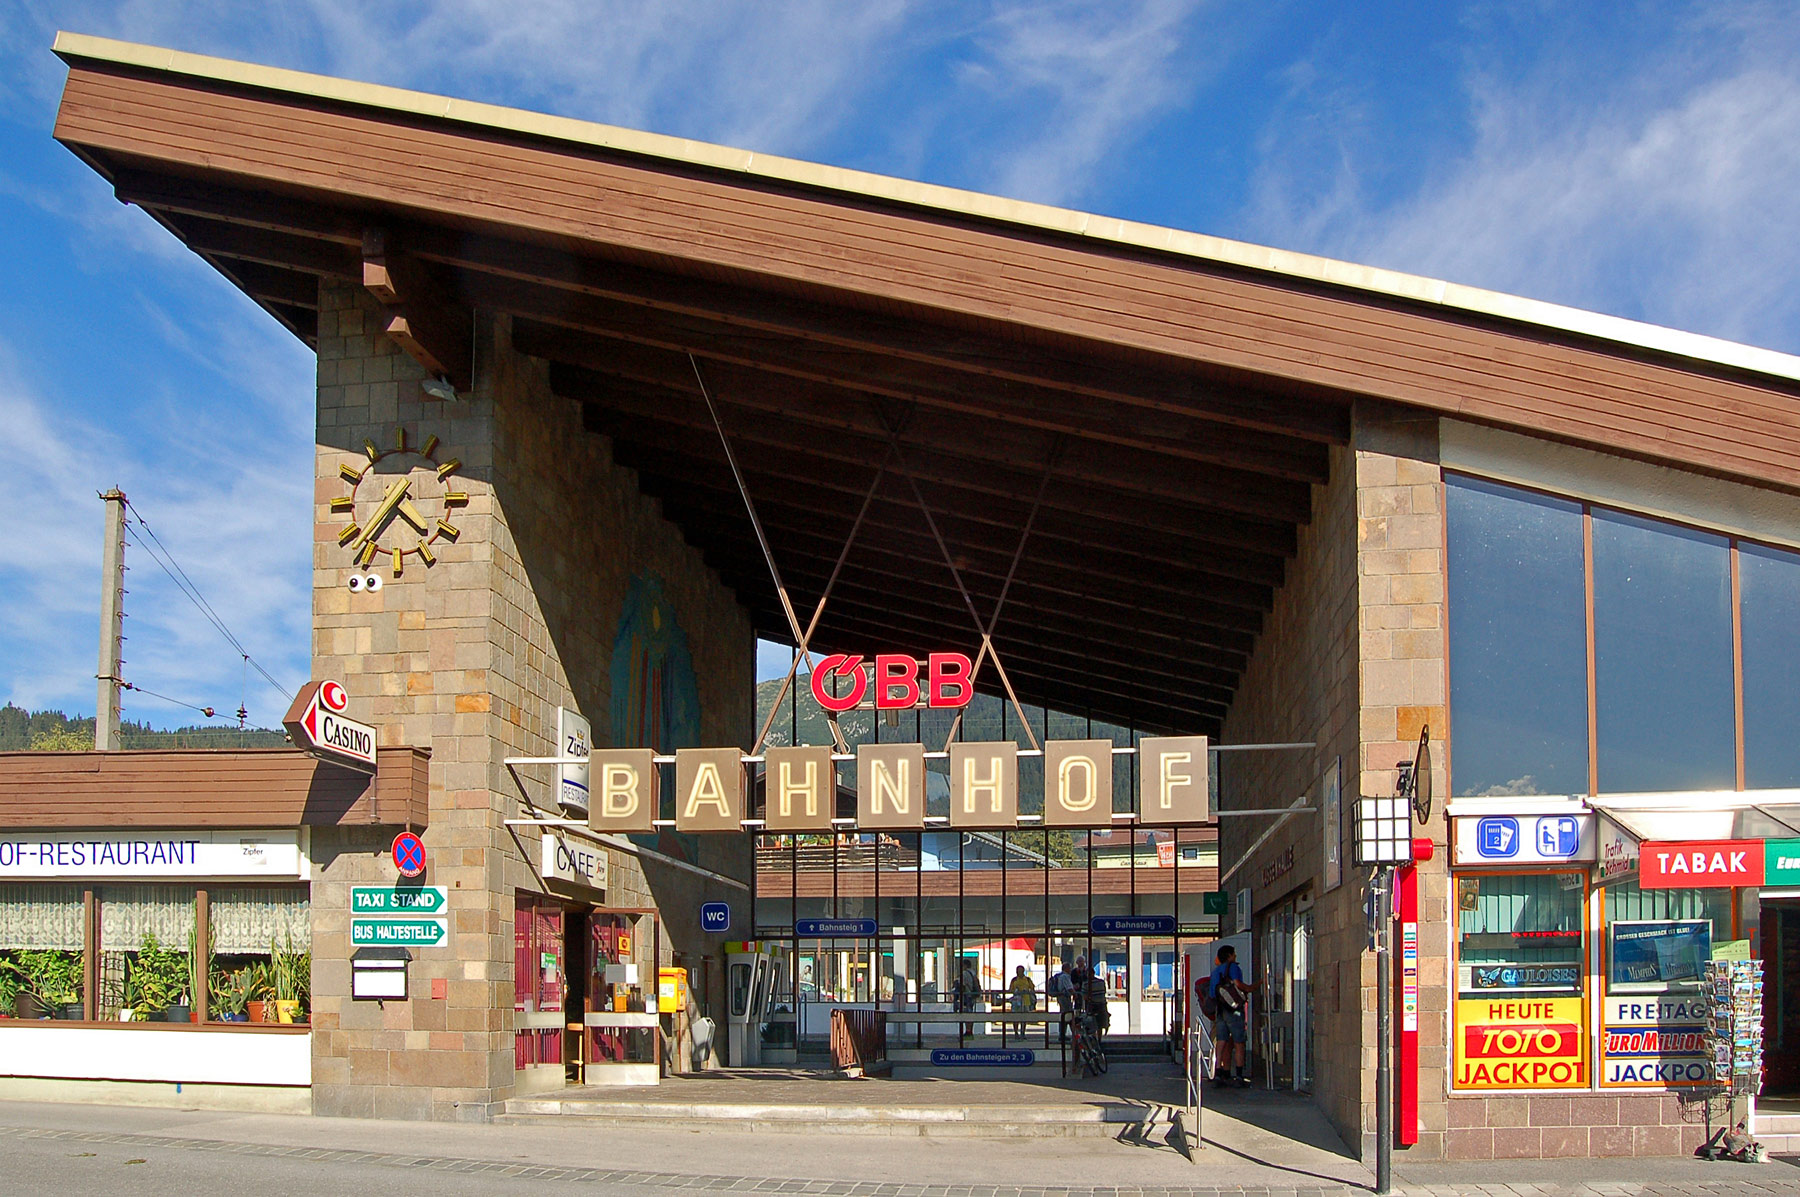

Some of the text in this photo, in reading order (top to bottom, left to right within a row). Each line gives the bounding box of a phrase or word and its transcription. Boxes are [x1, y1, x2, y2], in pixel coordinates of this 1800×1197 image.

[811, 653, 974, 711] ÖBB
[323, 716, 371, 755] CASINO
[602, 752, 1192, 819] BAHNHOF
[0, 840, 200, 866] OF-RESTAURANT
[1604, 838, 1624, 857] Trafik
[399, 866, 421, 876] ANFANG
[556, 845, 594, 879] CAFE
[1605, 854, 1629, 876] Schmid
[1657, 852, 1747, 874] TABAK
[355, 893, 435, 908] TAXI STAND
[706, 912, 725, 921] WC
[354, 925, 438, 940] BUS HALTESTELLE
[819, 923, 857, 932] Bahnsteig
[1115, 921, 1155, 932] Bahnsteig
[1501, 968, 1577, 983] GAULOISES
[1489, 1003, 1553, 1019] HEUTE
[1619, 1003, 1706, 1020] FREITAG
[1482, 1029, 1562, 1054] TOTO
[966, 1053, 1011, 1061] Bahnsteigen
[1458, 1062, 1584, 1084] JACKPOT
